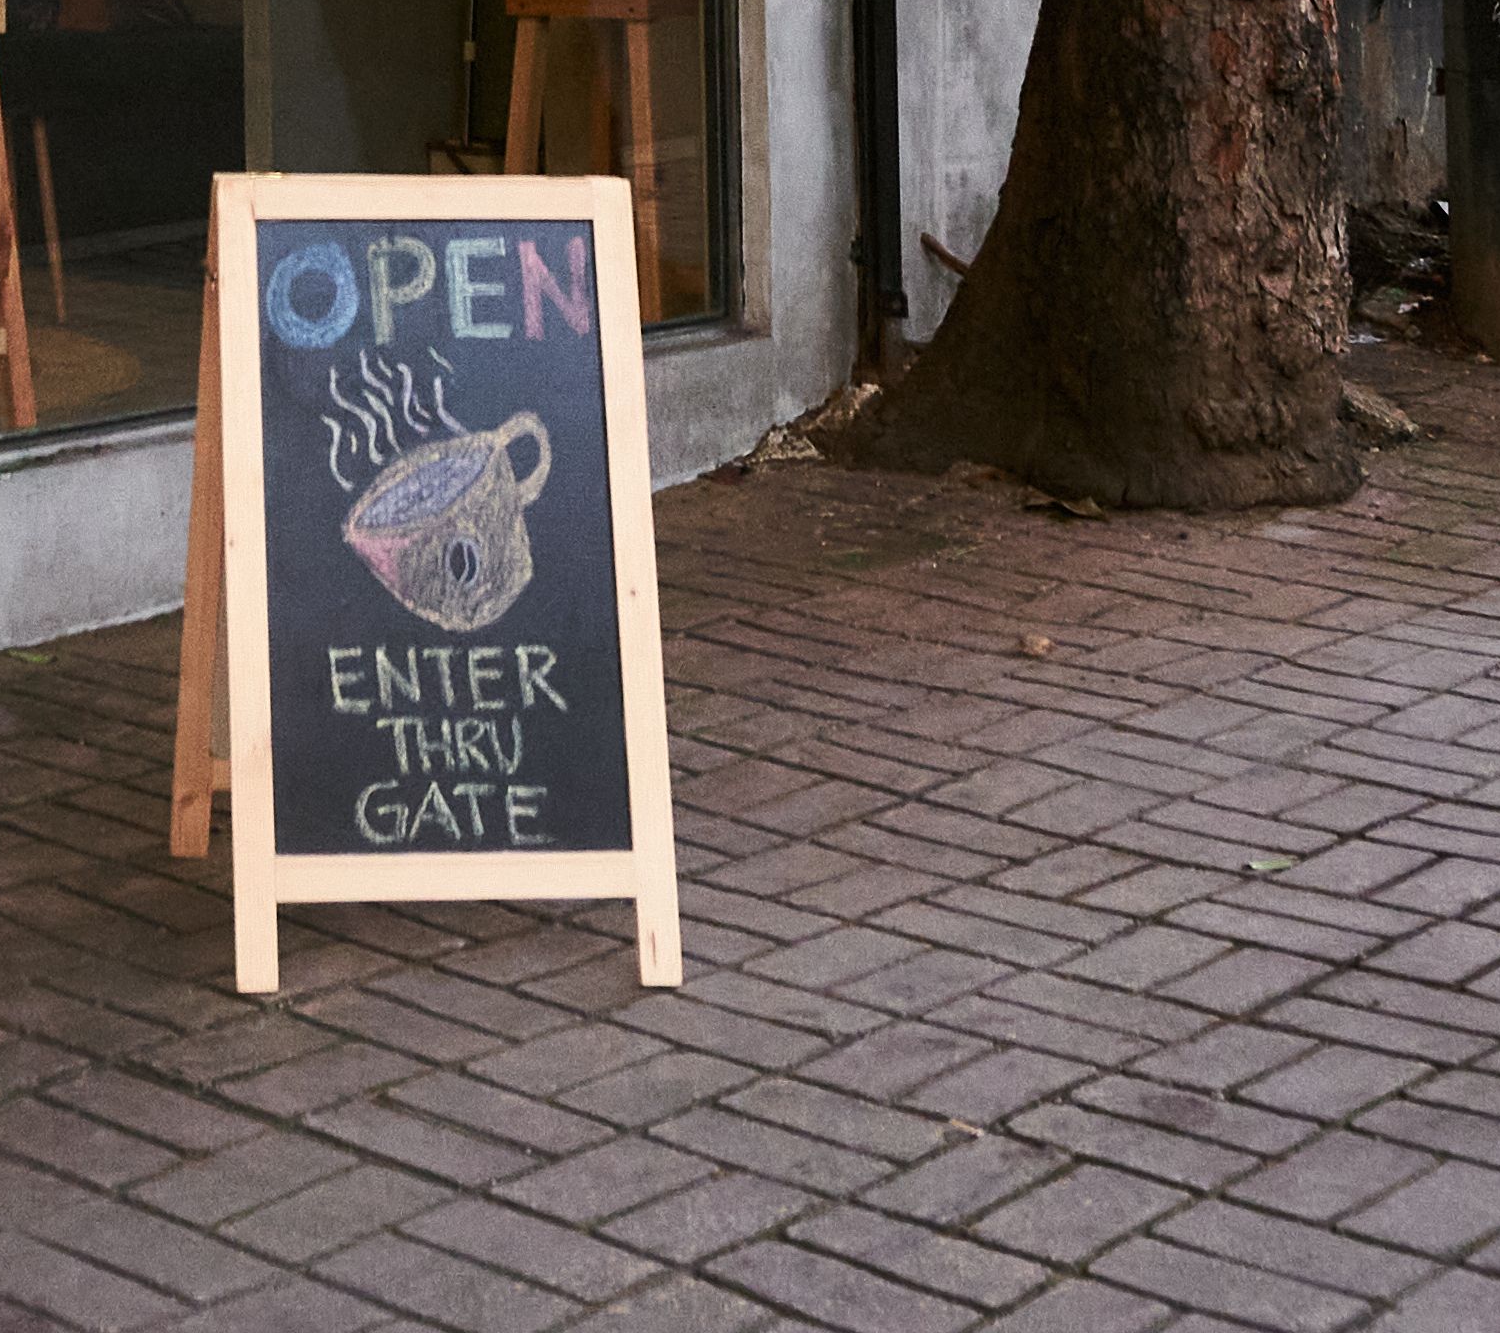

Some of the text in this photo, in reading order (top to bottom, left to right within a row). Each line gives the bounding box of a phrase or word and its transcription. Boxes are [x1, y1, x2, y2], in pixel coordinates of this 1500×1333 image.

[265, 235, 592, 349] OPEN
[327, 644, 568, 713] ENTER
[375, 714, 524, 775] THRU
[354, 779, 555, 846] GATE
